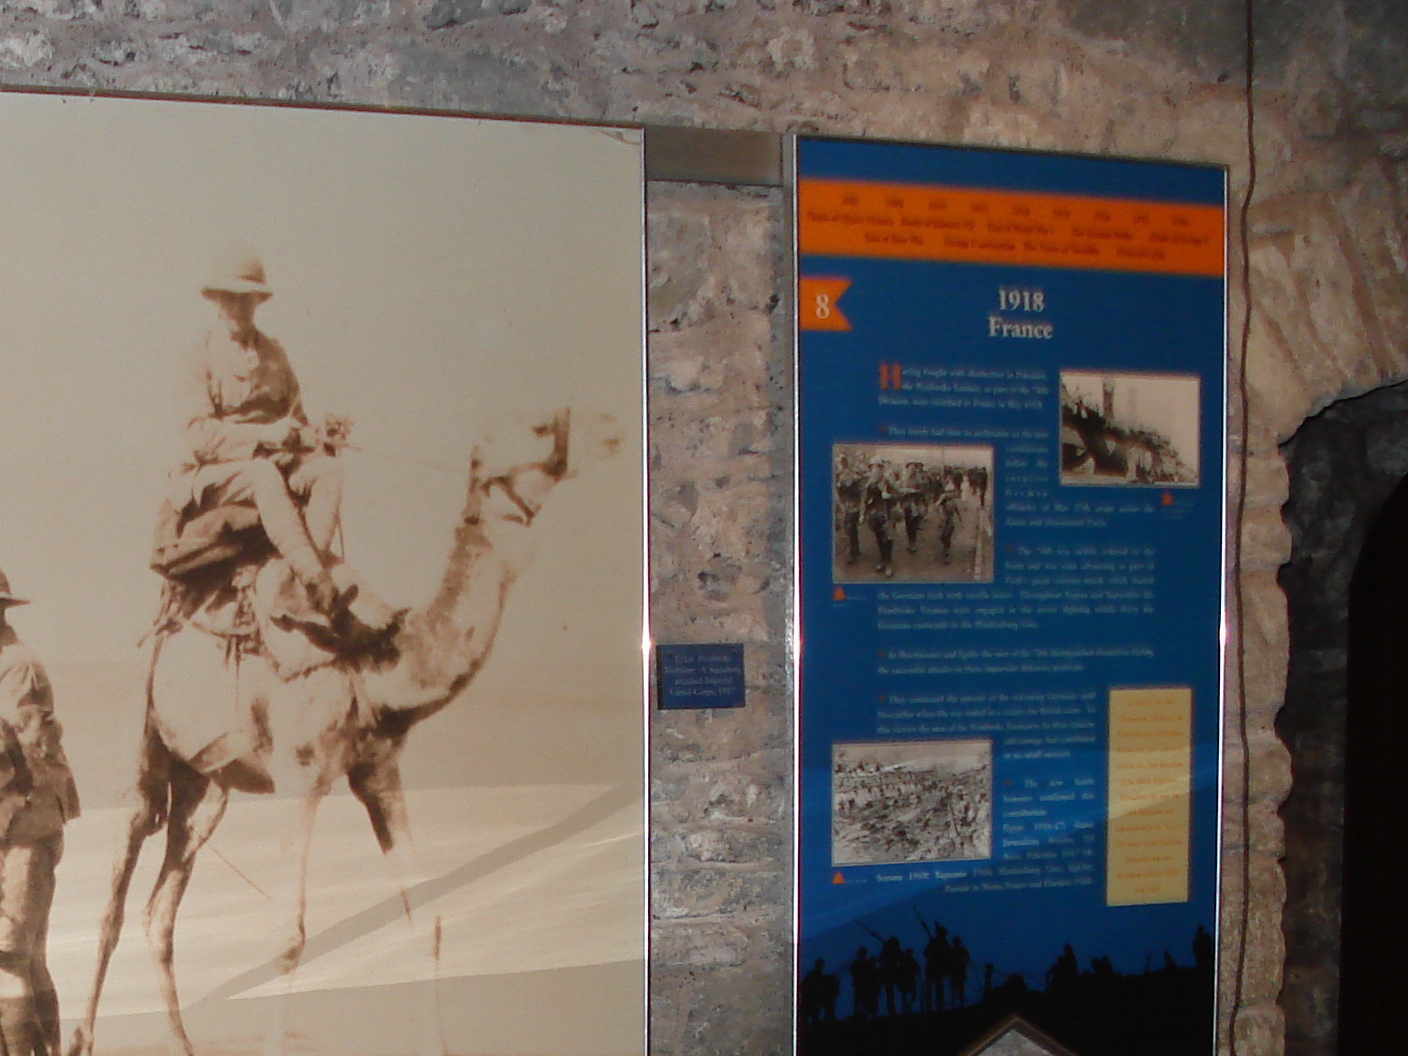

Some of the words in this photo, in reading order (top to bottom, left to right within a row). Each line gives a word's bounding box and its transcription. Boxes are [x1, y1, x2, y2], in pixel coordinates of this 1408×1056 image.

[815, 294, 831, 319] 8
[998, 288, 1046, 312] 1918
[988, 316, 1054, 340] France
